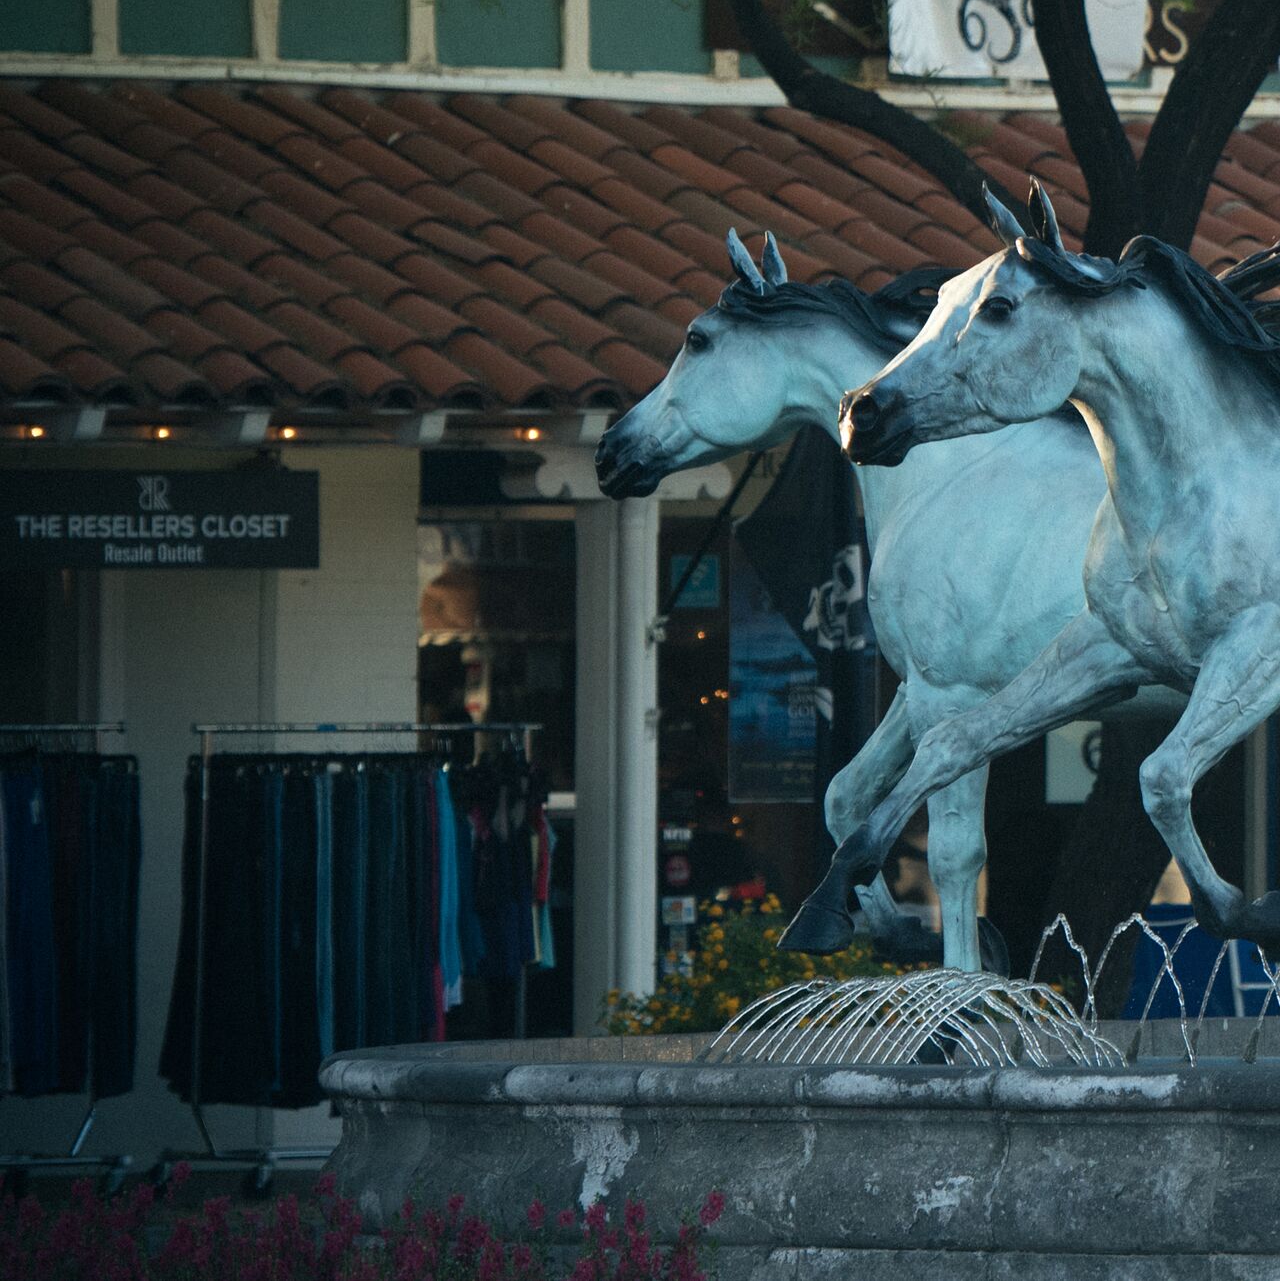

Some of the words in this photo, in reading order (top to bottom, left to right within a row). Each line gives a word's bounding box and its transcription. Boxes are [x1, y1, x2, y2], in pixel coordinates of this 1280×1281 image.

[16, 515, 61, 538] THE
[68, 515, 195, 538] RESELLERS
[201, 515, 290, 538] CLOSET
[104, 543, 152, 563] Resale
[157, 543, 204, 563] Outlet
